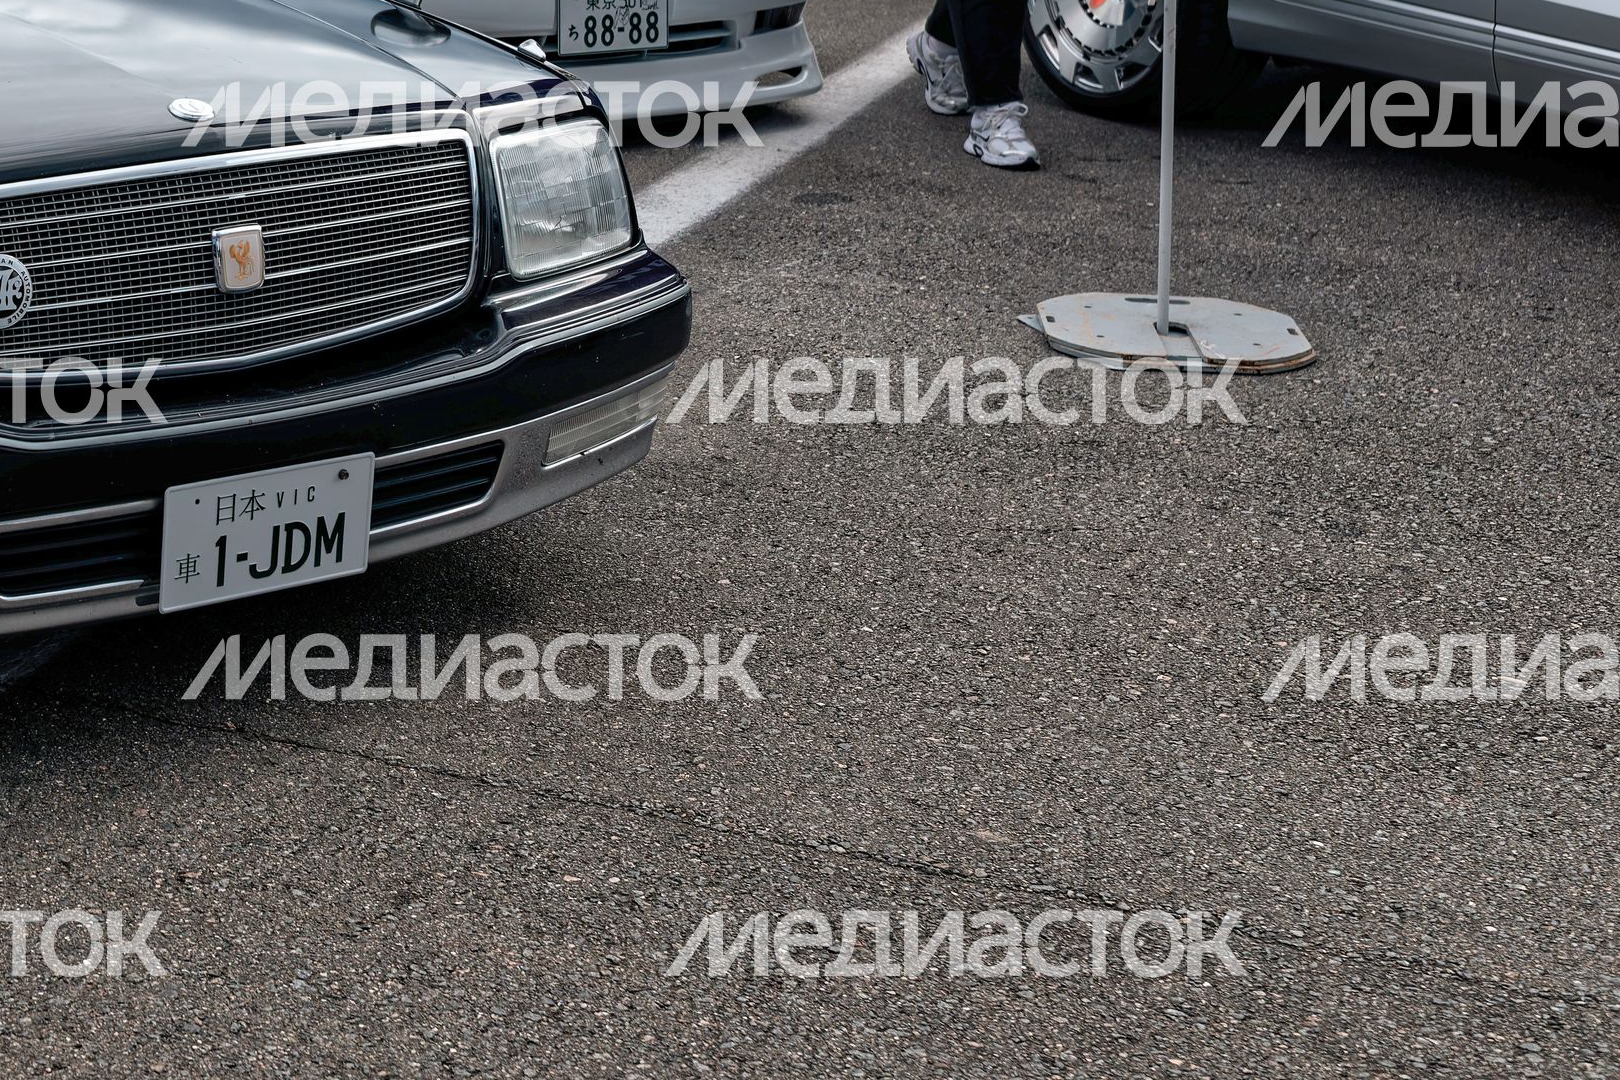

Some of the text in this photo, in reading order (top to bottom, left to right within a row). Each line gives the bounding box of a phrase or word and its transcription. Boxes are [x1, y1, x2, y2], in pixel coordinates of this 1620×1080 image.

[568, 24, 579, 41] ち
[583, 10, 660, 48] 88-88
[216, 485, 316, 526] 日本 VIC
[174, 511, 346, 588] 車 1-JDM
